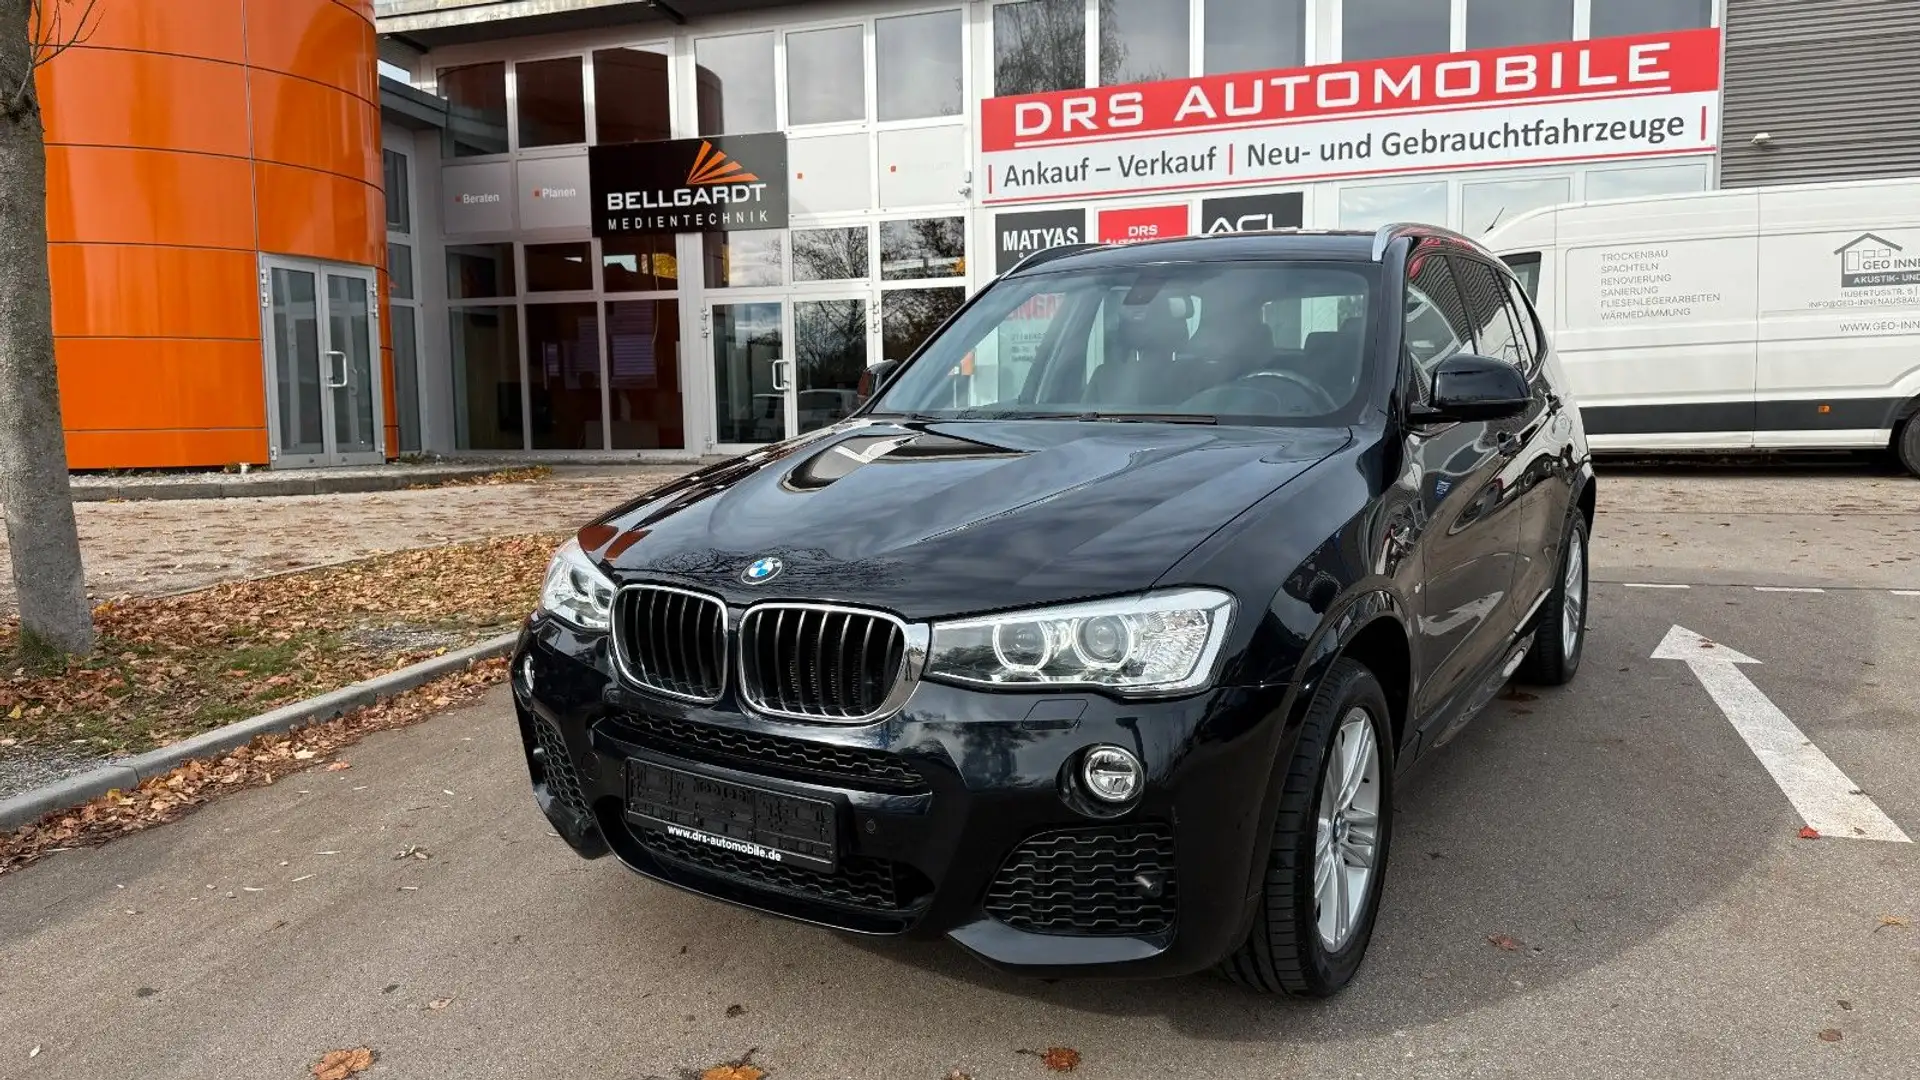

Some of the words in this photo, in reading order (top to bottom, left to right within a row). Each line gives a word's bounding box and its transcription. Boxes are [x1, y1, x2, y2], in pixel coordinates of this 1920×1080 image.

[1014, 91, 1144, 137] DRS
[1173, 41, 1671, 122] AUTOMOBILE
[1003, 157, 1091, 187] Ankauf
[1117, 146, 1217, 177] Verkauf
[1247, 142, 1311, 168] Neu-
[1320, 132, 1372, 161] und
[1381, 115, 1685, 157] Gebrauchtfahrzeuge
[462, 192, 500, 205] Beraten
[541, 186, 577, 199] Planen
[606, 183, 767, 211] BELLGARDT
[607, 209, 769, 231] MEDIENTECHNIK
[1127, 224, 1158, 237] DRS
[1003, 226, 1079, 251] MATYAS
[1601, 249, 1669, 262] TROCKENBAU
[1600, 262, 1659, 274] SPACHTELN
[1862, 259, 1891, 270] GEO
[1600, 273, 1672, 286] RENOVIERUNG
[1853, 273, 1900, 285] AKUSTIK-
[1600, 285, 1659, 297] SANIERUNG
[1600, 293, 1721, 308] FLIESENLEGERARBEITEN
[1600, 307, 1691, 320] WÄRMEDÄMMUNG
[667, 825, 782, 862] www.drs-automobile.de
